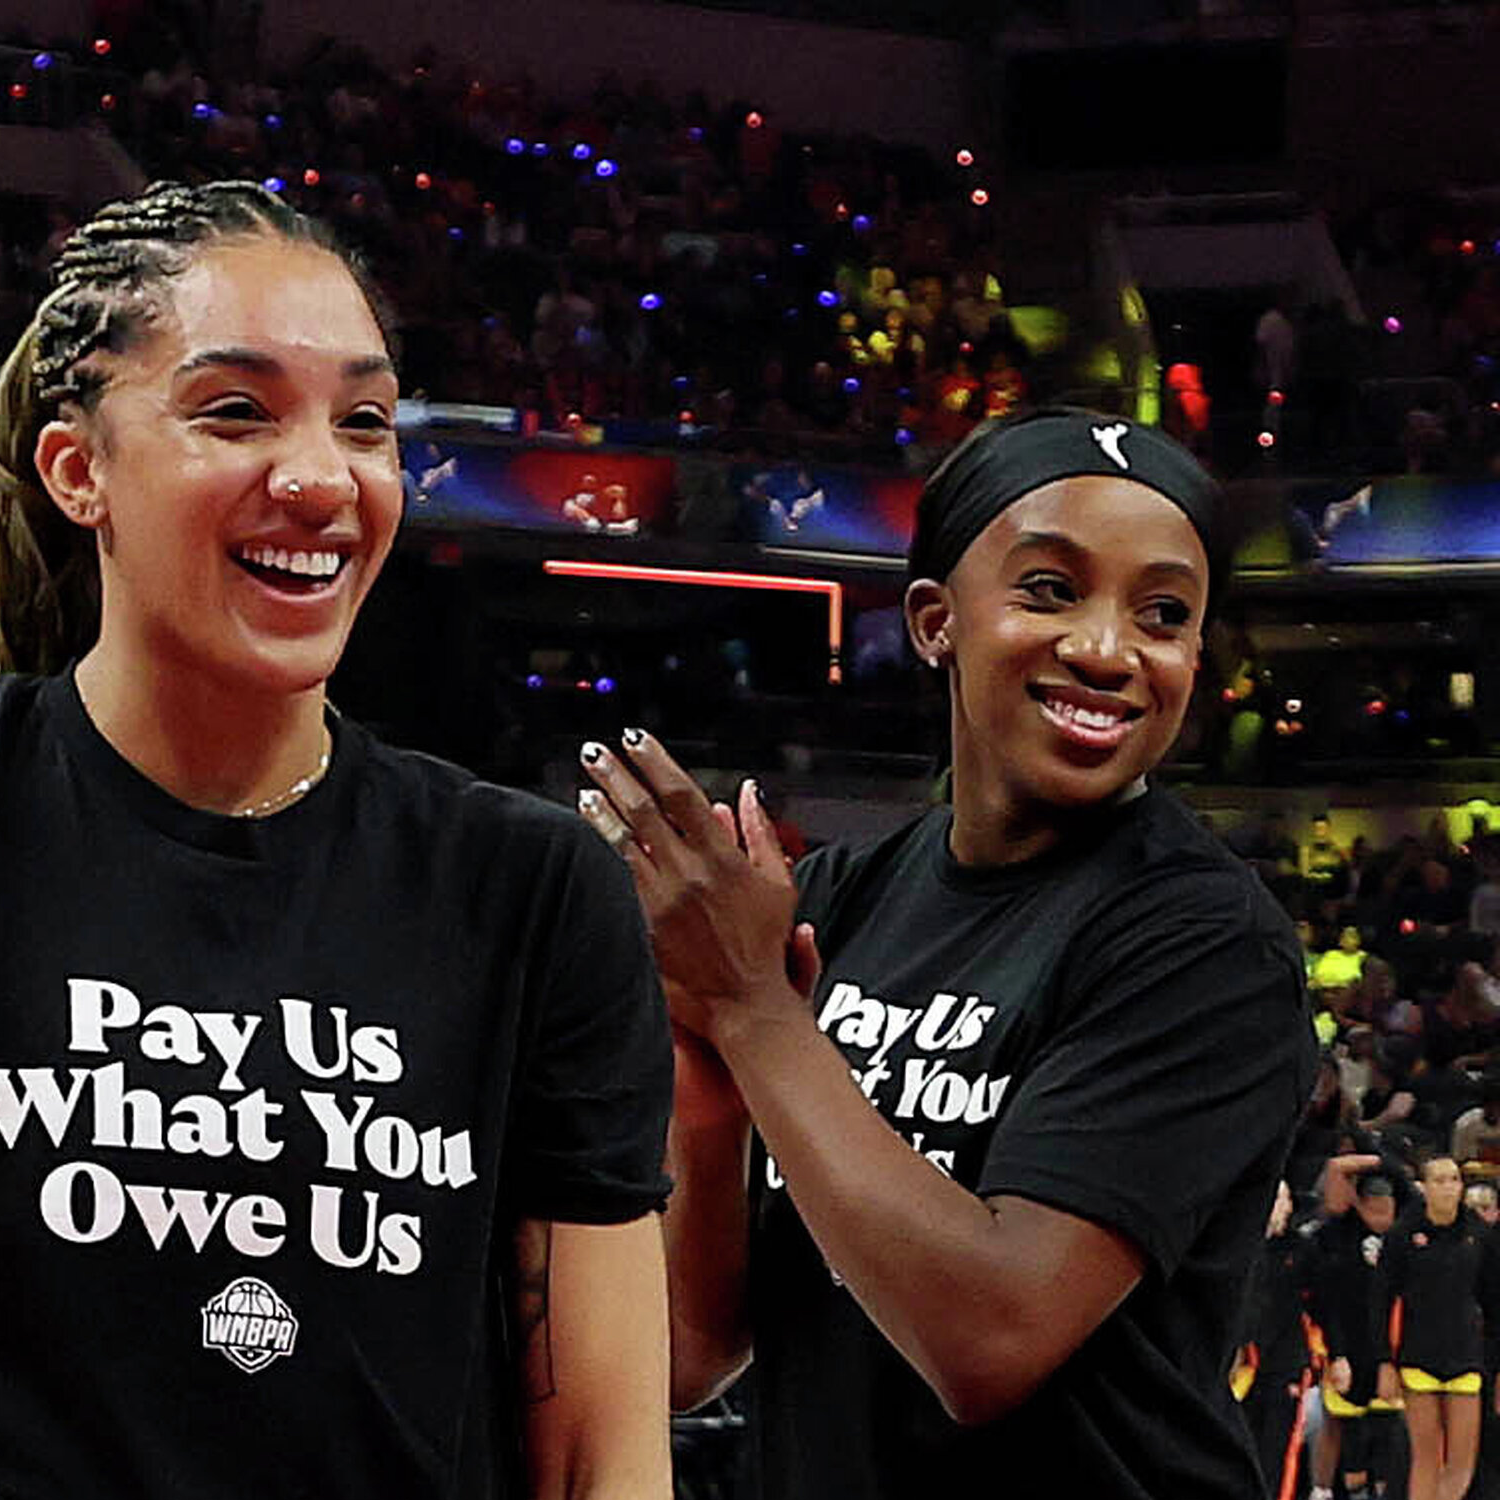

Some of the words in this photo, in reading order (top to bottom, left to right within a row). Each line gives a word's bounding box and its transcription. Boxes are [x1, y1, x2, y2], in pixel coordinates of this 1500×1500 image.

[67, 978, 263, 1092] Pay
[278, 998, 404, 1083] Us
[817, 982, 924, 1066] Pay
[913, 992, 996, 1051] Us
[893, 1058, 1011, 1125] You
[300, 1089, 478, 1190] You
[39, 1161, 287, 1257] Owe
[309, 1184, 422, 1275] Us
[208, 1312, 294, 1351] WNBPA
